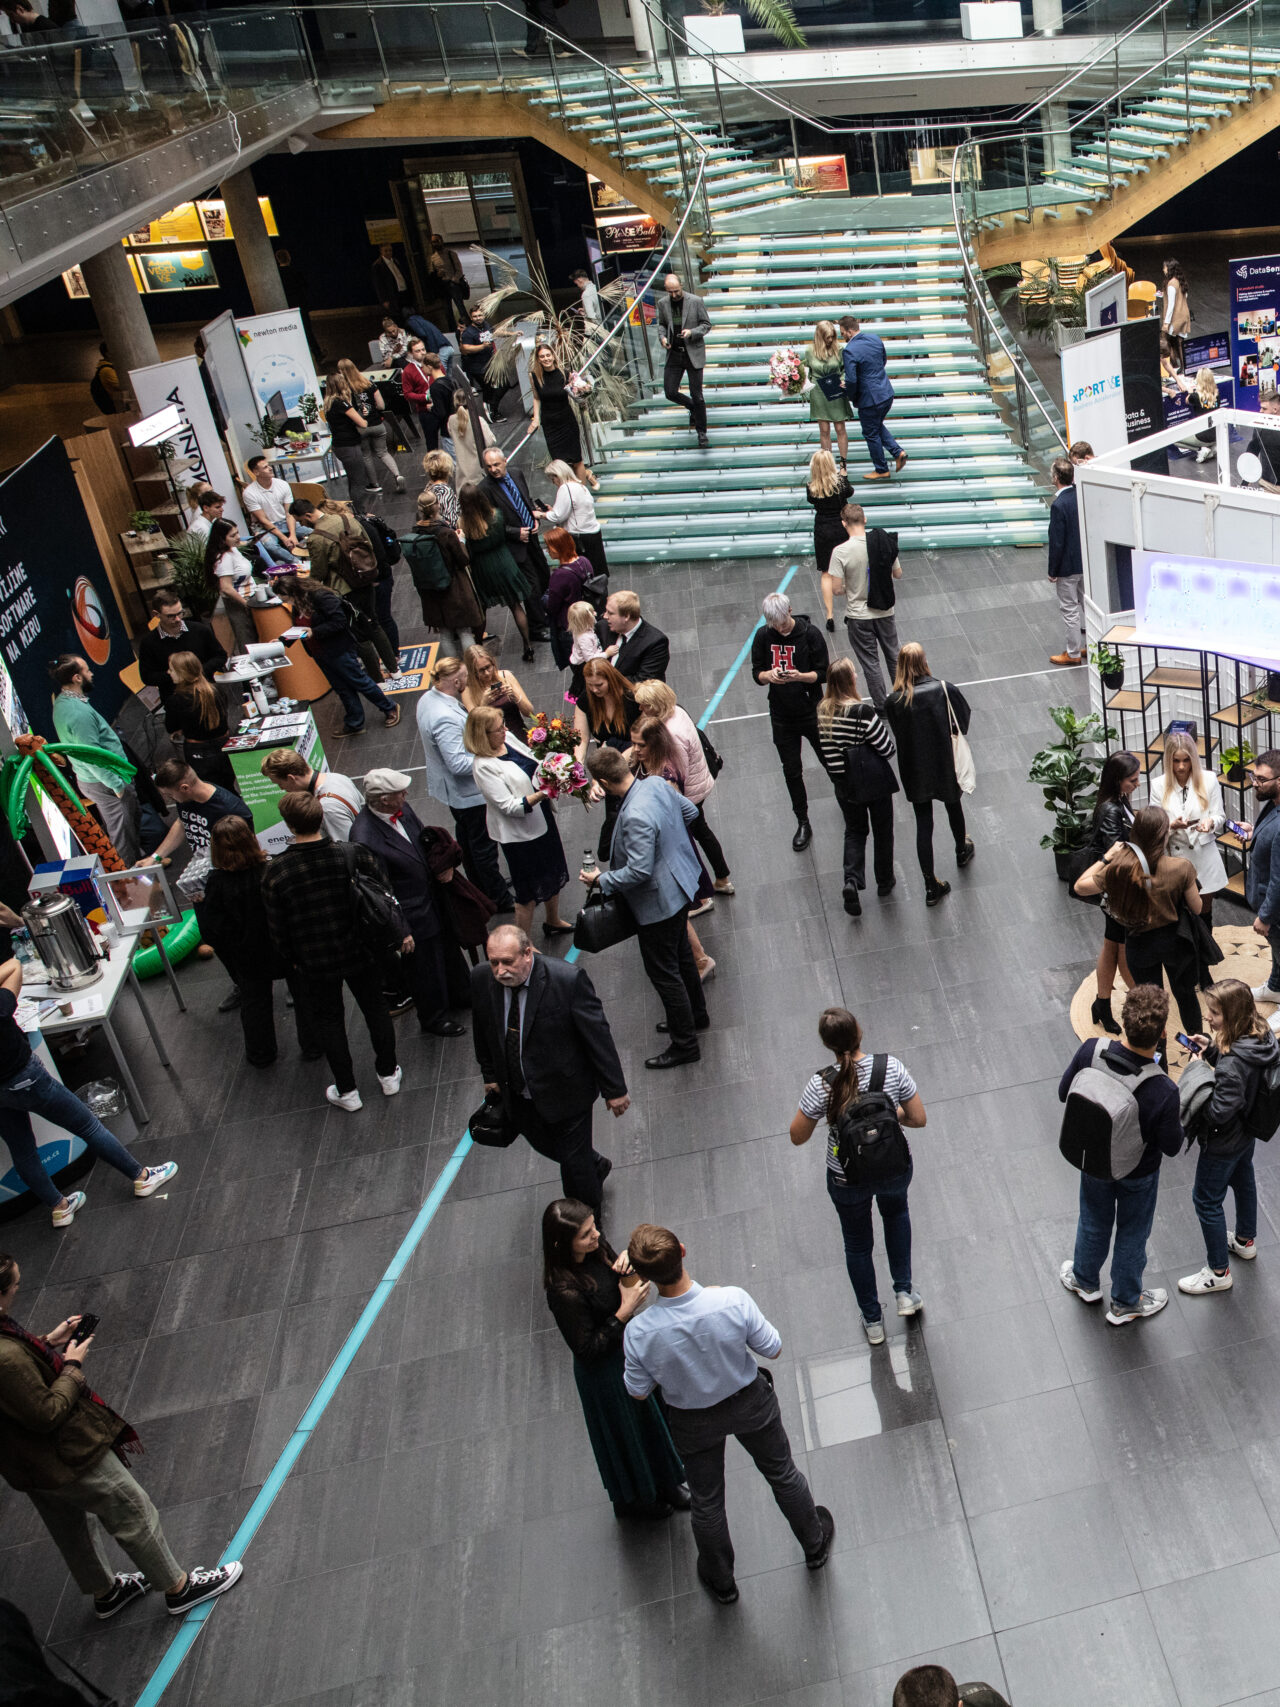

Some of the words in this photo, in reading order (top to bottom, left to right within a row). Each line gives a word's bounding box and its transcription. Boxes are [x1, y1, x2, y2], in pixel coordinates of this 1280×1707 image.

[253, 328, 277, 338] newton
[278, 323, 298, 333] media
[1073, 380, 1105, 403] xPORT
[1126, 416, 1151, 428] usiness
[0, 585, 37, 638] SOFTWARE
[5, 639, 21, 664] NA
[18, 614, 42, 649] MÍRU
[771, 644, 796, 670] H
[189, 812, 208, 827] CEO
[190, 823, 212, 838] COO
[61, 879, 92, 897] Bull
